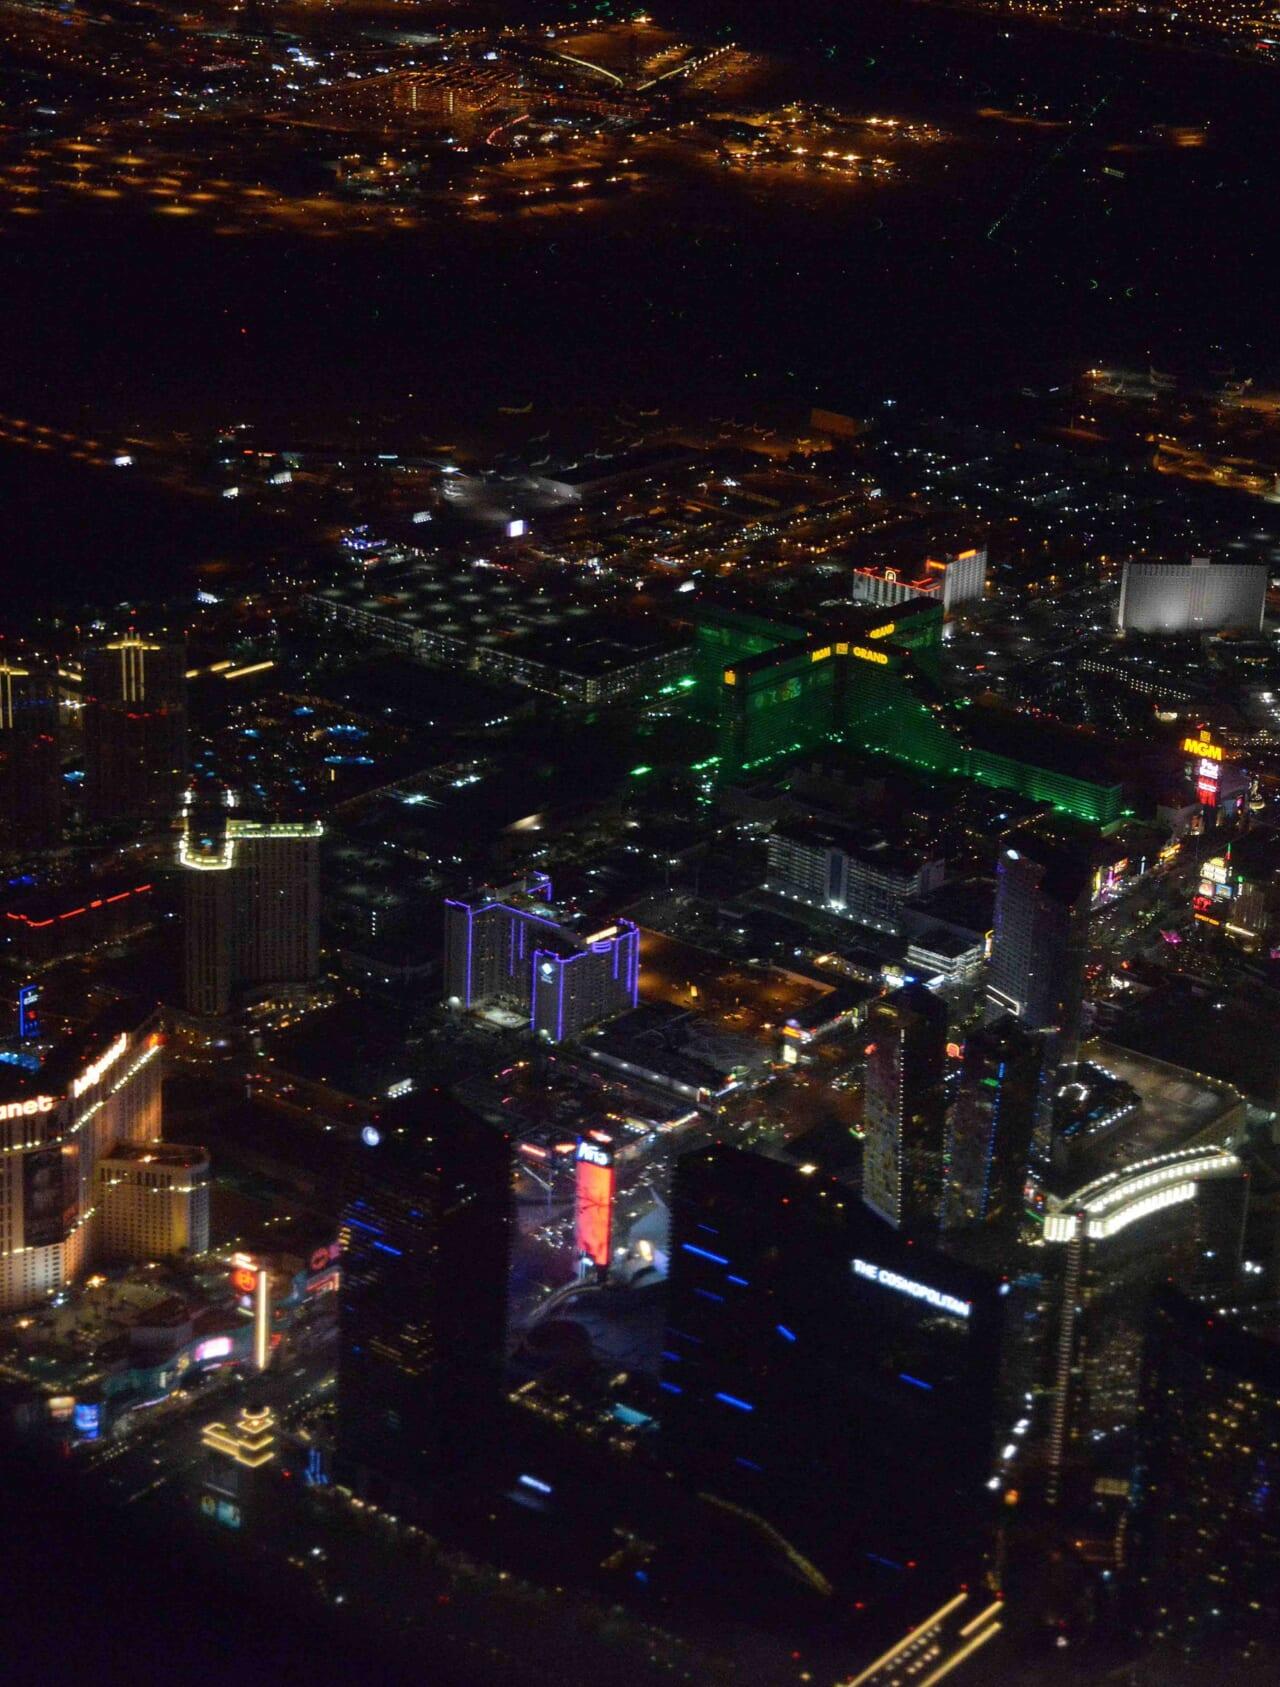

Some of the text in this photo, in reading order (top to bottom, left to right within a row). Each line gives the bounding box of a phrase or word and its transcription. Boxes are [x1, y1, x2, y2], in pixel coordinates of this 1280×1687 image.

[853, 646, 888, 665] GRAND
[1183, 738, 1222, 760] MGM
[853, 1259, 970, 1316] THE COSMOPOLITAN
